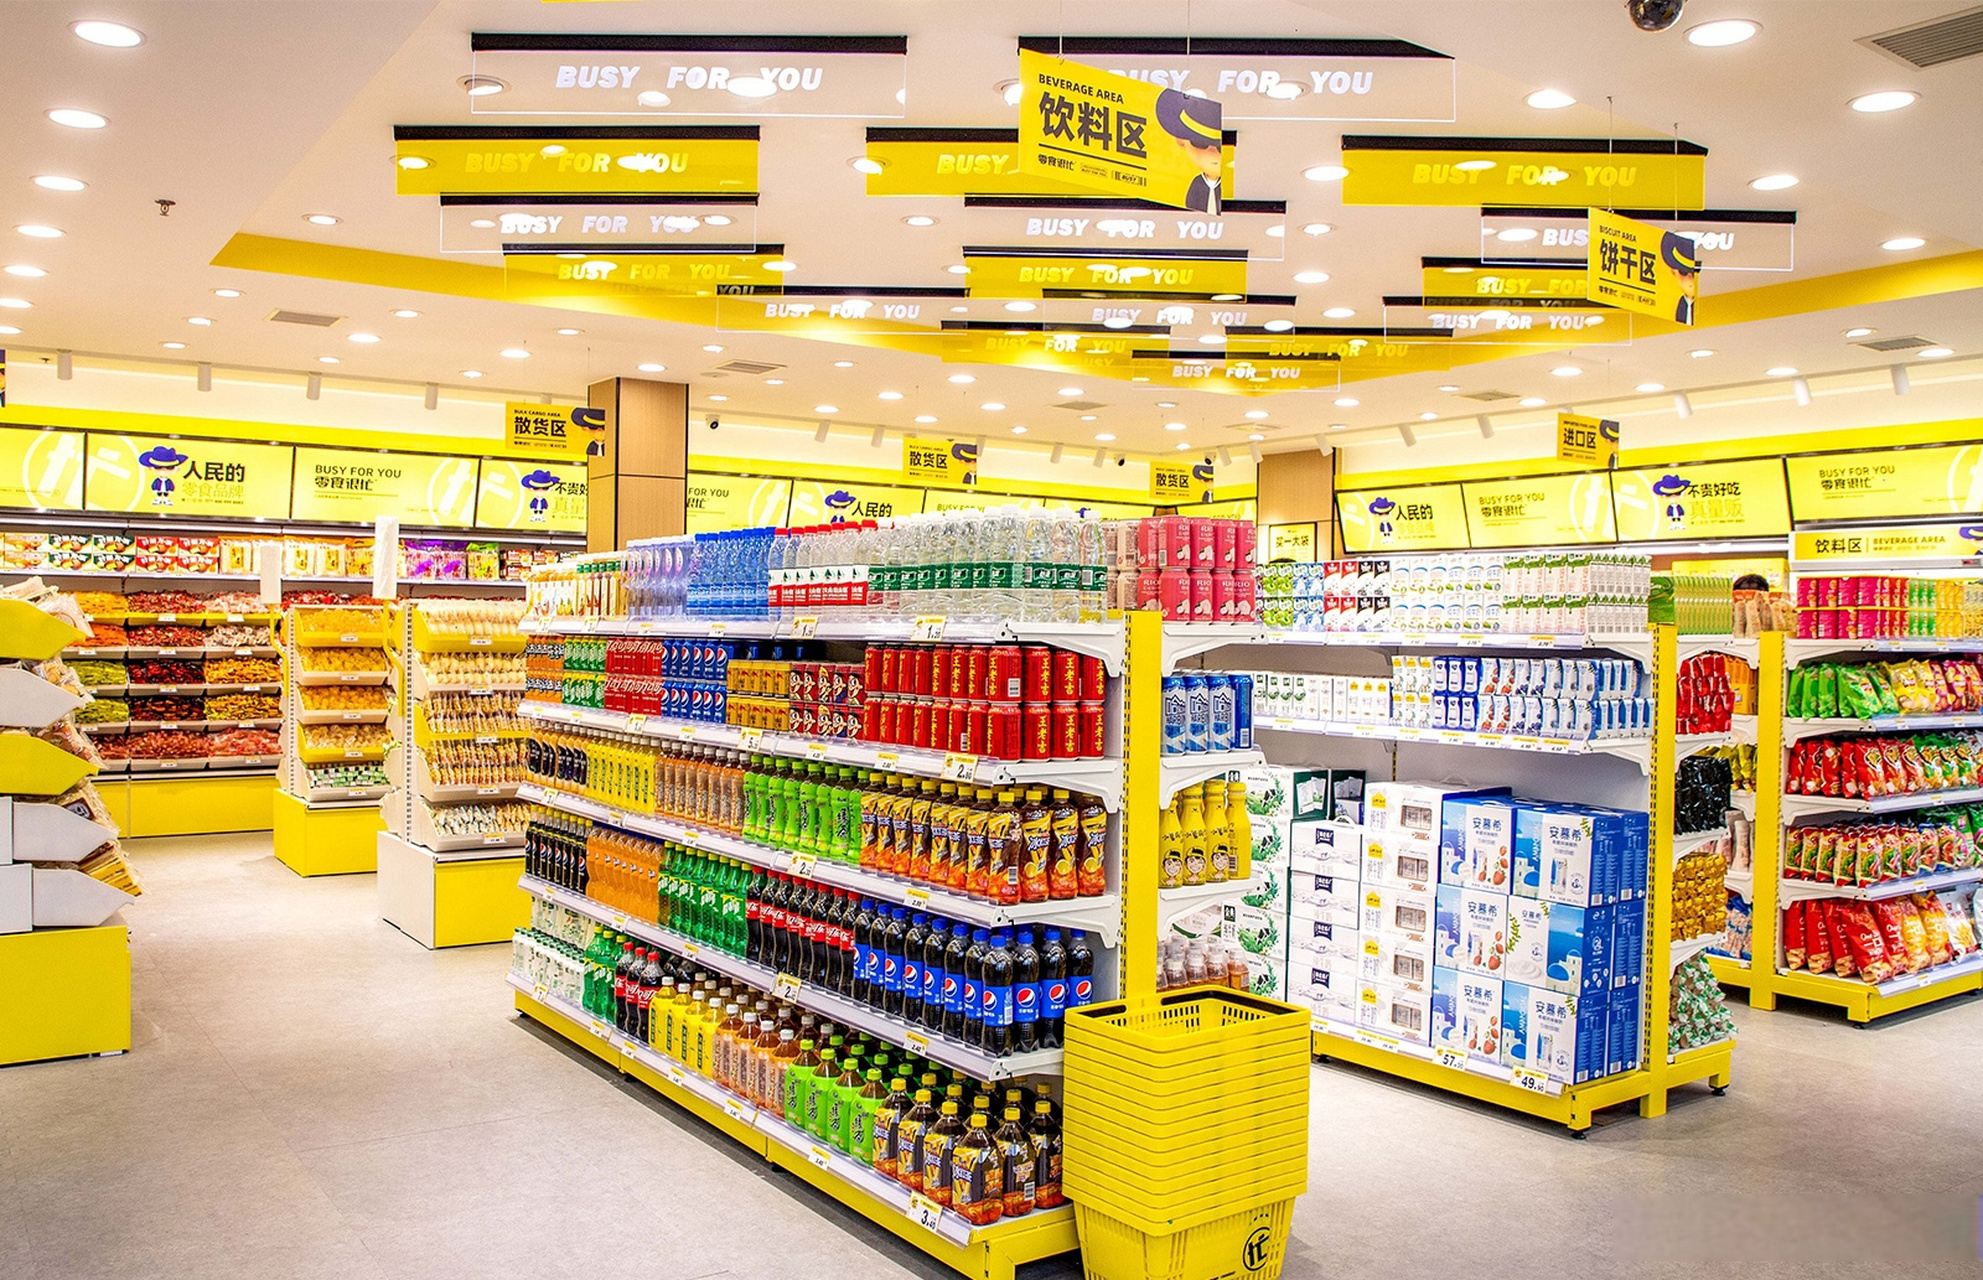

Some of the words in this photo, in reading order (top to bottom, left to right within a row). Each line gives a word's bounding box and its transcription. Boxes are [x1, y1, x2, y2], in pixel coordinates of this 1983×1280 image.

[555, 65, 640, 89] BUSY
[666, 66, 731, 90] FOR
[759, 67, 824, 91] YOU
[1218, 70, 1280, 95] FOR
[1311, 71, 1374, 95] YOU
[1038, 73, 1093, 97] BEVERAGE
[1096, 88, 1125, 105] AREA
[1038, 91, 1148, 159] 饮料区
[464, 152, 535, 173] BUSY
[558, 152, 610, 173] FOR
[633, 152, 689, 174] YOU
[936, 153, 1010, 175] BUSY
[1412, 163, 1481, 185] BUSY
[1506, 164, 1560, 186] FOR
[1583, 166, 1637, 187] YOU
[501, 215, 563, 234] BUSY
[582, 216, 628, 234] FOR
[1026, 218, 1089, 237] BUSY
[1108, 220, 1156, 239] FOR
[1177, 221, 1225, 240] YOU
[1600, 238, 1656, 286] 饼干区
[558, 264, 612, 281] BUSY
[629, 264, 671, 280] FOR
[689, 264, 731, 280] YOU
[1018, 266, 1075, 284] BUSY
[1091, 267, 1132, 285] FOR
[1152, 269, 1194, 285] YOU
[1477, 277, 1531, 294] BUSY
[1549, 279, 1588, 296] FOR
[764, 303, 816, 319] BUSY
[829, 304, 868, 319] FOR
[883, 304, 921, 319] YOU
[1092, 308, 1141, 322] BUSY
[1156, 309, 1194, 325] FOR
[1210, 311, 1248, 325] YOU
[1433, 314, 1480, 329] BUSY
[1496, 314, 1533, 330] FOR
[1549, 315, 1585, 330] YOU
[985, 337, 1031, 350] BUSY
[1044, 339, 1077, 352] FOR
[1093, 340, 1127, 353] YOU
[1269, 342, 1314, 356] BUSY
[1326, 343, 1361, 357] FOR
[1375, 344, 1408, 357] YOU
[1172, 365, 1213, 378] BUSY
[1225, 366, 1257, 379] FOR
[1270, 366, 1301, 379] YOU
[514, 416, 566, 437] 散货区
[1563, 428, 1597, 450] 进口区
[909, 450, 948, 469] 散货区
[183, 461, 246, 483] 人民的
[315, 464, 347, 476] BUSY
[350, 465, 374, 477] FOR
[377, 467, 402, 479] YOU
[1819, 468, 1846, 479] BUSY
[1849, 466, 1870, 477] FOR
[1872, 465, 1895, 476] YOU
[1155, 473, 1190, 489] 散货区
[1688, 481, 1741, 498] 不贵好吃
[688, 487, 708, 497] FOR
[709, 488, 730, 498] YOU
[1479, 495, 1503, 506] BUSY
[1504, 493, 1524, 504] FOR
[1525, 492, 1545, 502] YOU
[852, 501, 892, 518] 人民的
[1396, 504, 1434, 521] 人民的
[1815, 538, 1862, 554] 饮料区
[1873, 536, 1919, 545] BEVERAGE
[1920, 535, 1946, 544] AREA
[1473, 816, 1502, 832] 安慕希
[1549, 826, 1581, 842] 安慕希
[1468, 901, 1497, 917] 安慕希
[1464, 985, 1492, 1002] 安慕希
[1536, 1000, 1567, 1019] 安慕希
